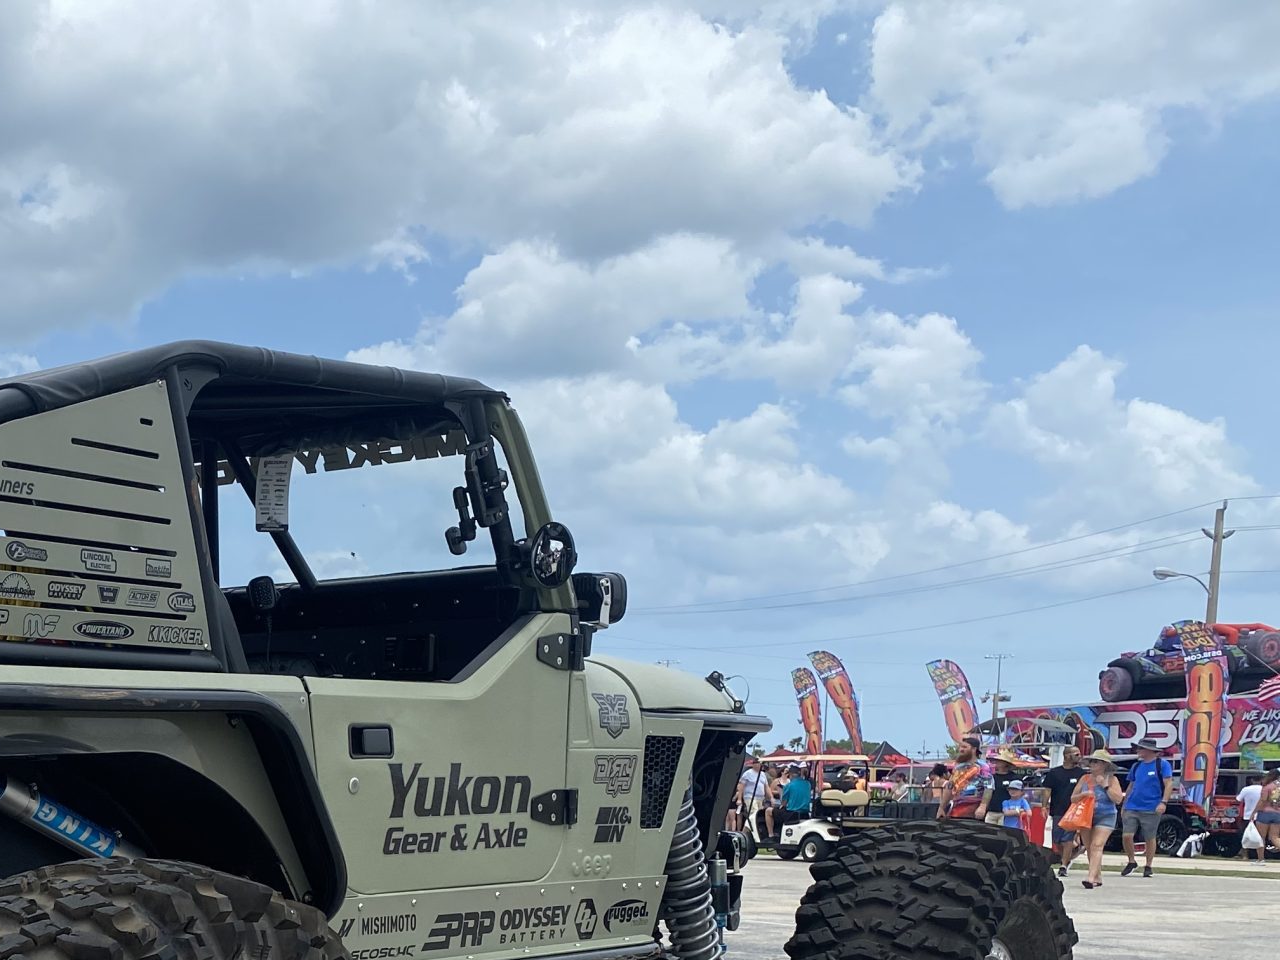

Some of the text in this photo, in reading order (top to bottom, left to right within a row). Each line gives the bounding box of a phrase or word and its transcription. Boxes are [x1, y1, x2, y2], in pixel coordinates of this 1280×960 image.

[83, 551, 111, 563] LINCOLN
[48, 582, 86, 593] ODYSSEY
[171, 594, 194, 607] ATLAS
[157, 625, 204, 645] KICKER
[1239, 723, 1280, 745] LOU
[387, 762, 532, 818] Yukon
[37, 802, 113, 853] KING
[383, 821, 528, 855] Gear & Axle
[361, 913, 417, 936] MISHIMOTO
[499, 904, 572, 931] ODYSSEY
[499, 927, 566, 944] BATTERY
